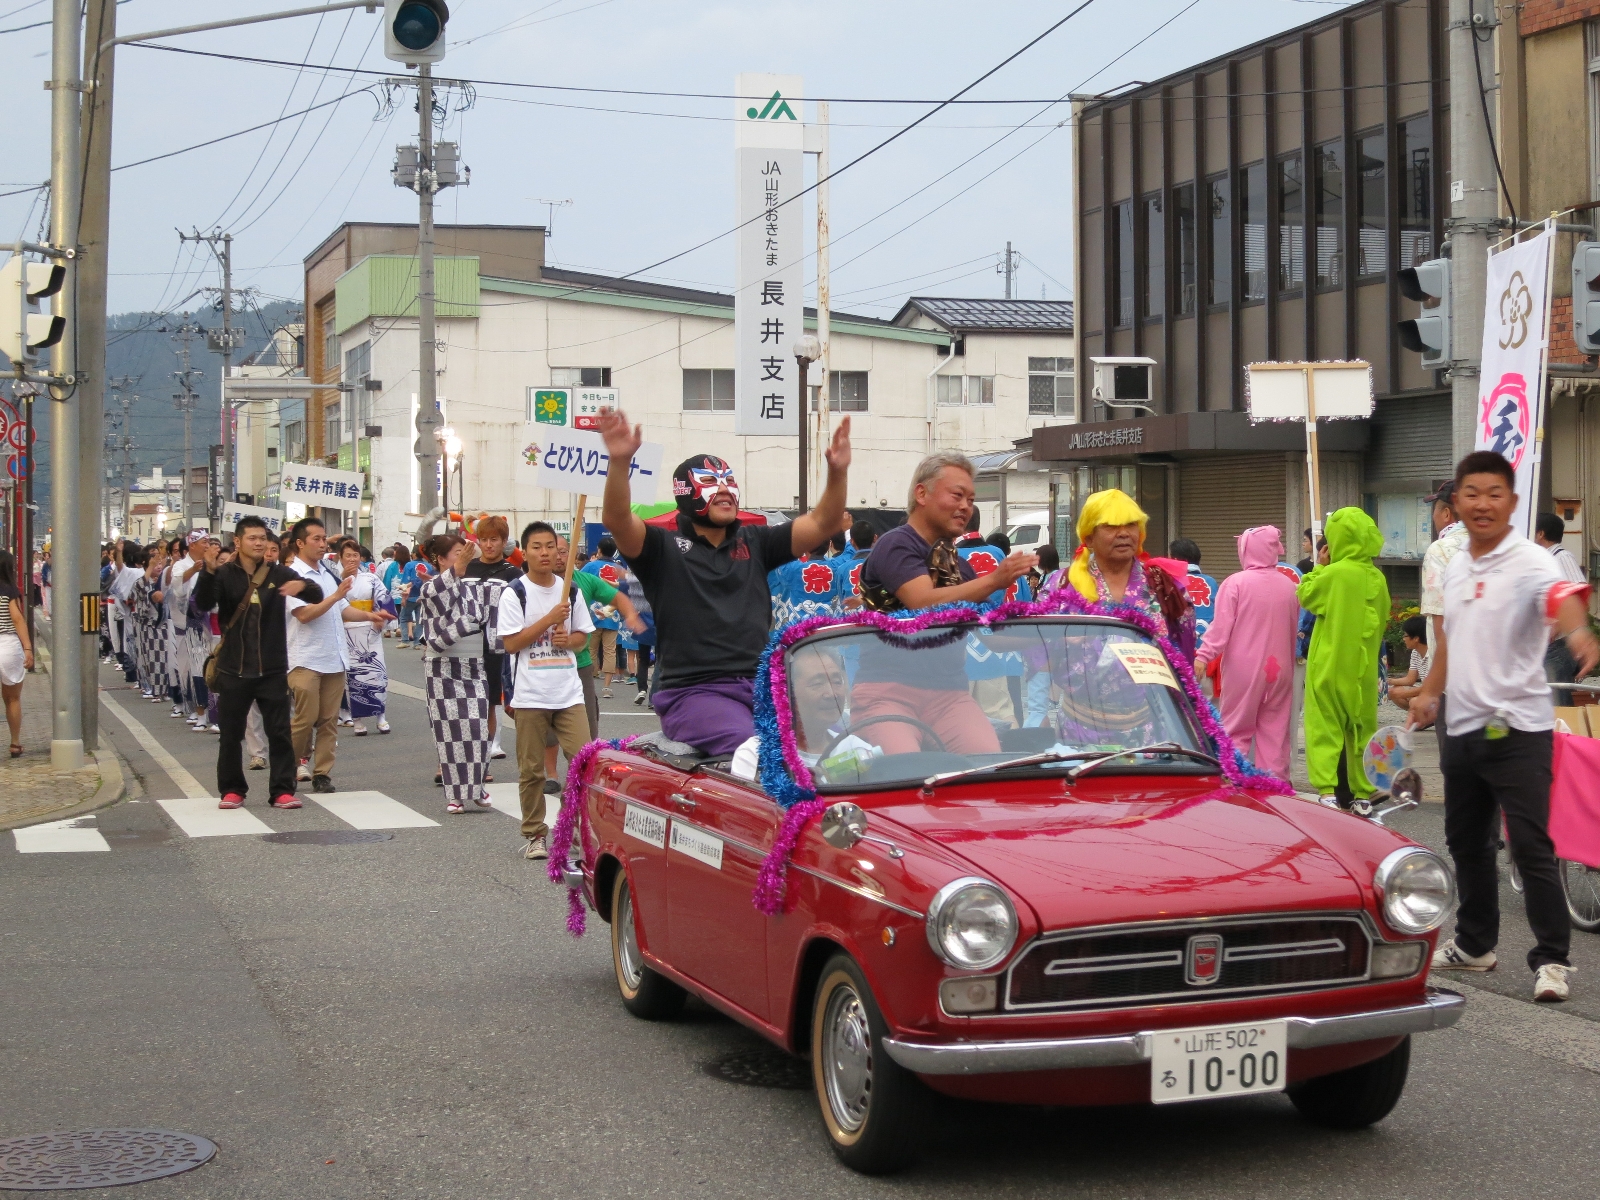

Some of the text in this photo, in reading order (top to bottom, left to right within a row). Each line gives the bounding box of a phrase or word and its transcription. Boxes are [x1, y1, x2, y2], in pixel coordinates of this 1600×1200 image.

[760, 280, 785, 420] 長井支店
[581, 393, 615, 401] 今日も一日
[543, 442, 653, 478] とび入りコナー
[294, 476, 361, 499] 長井市議会
[802, 563, 833, 594] 祭
[1185, 1028, 1258, 1053] 山形 502
[1160, 1050, 1278, 1094] る 10-00
